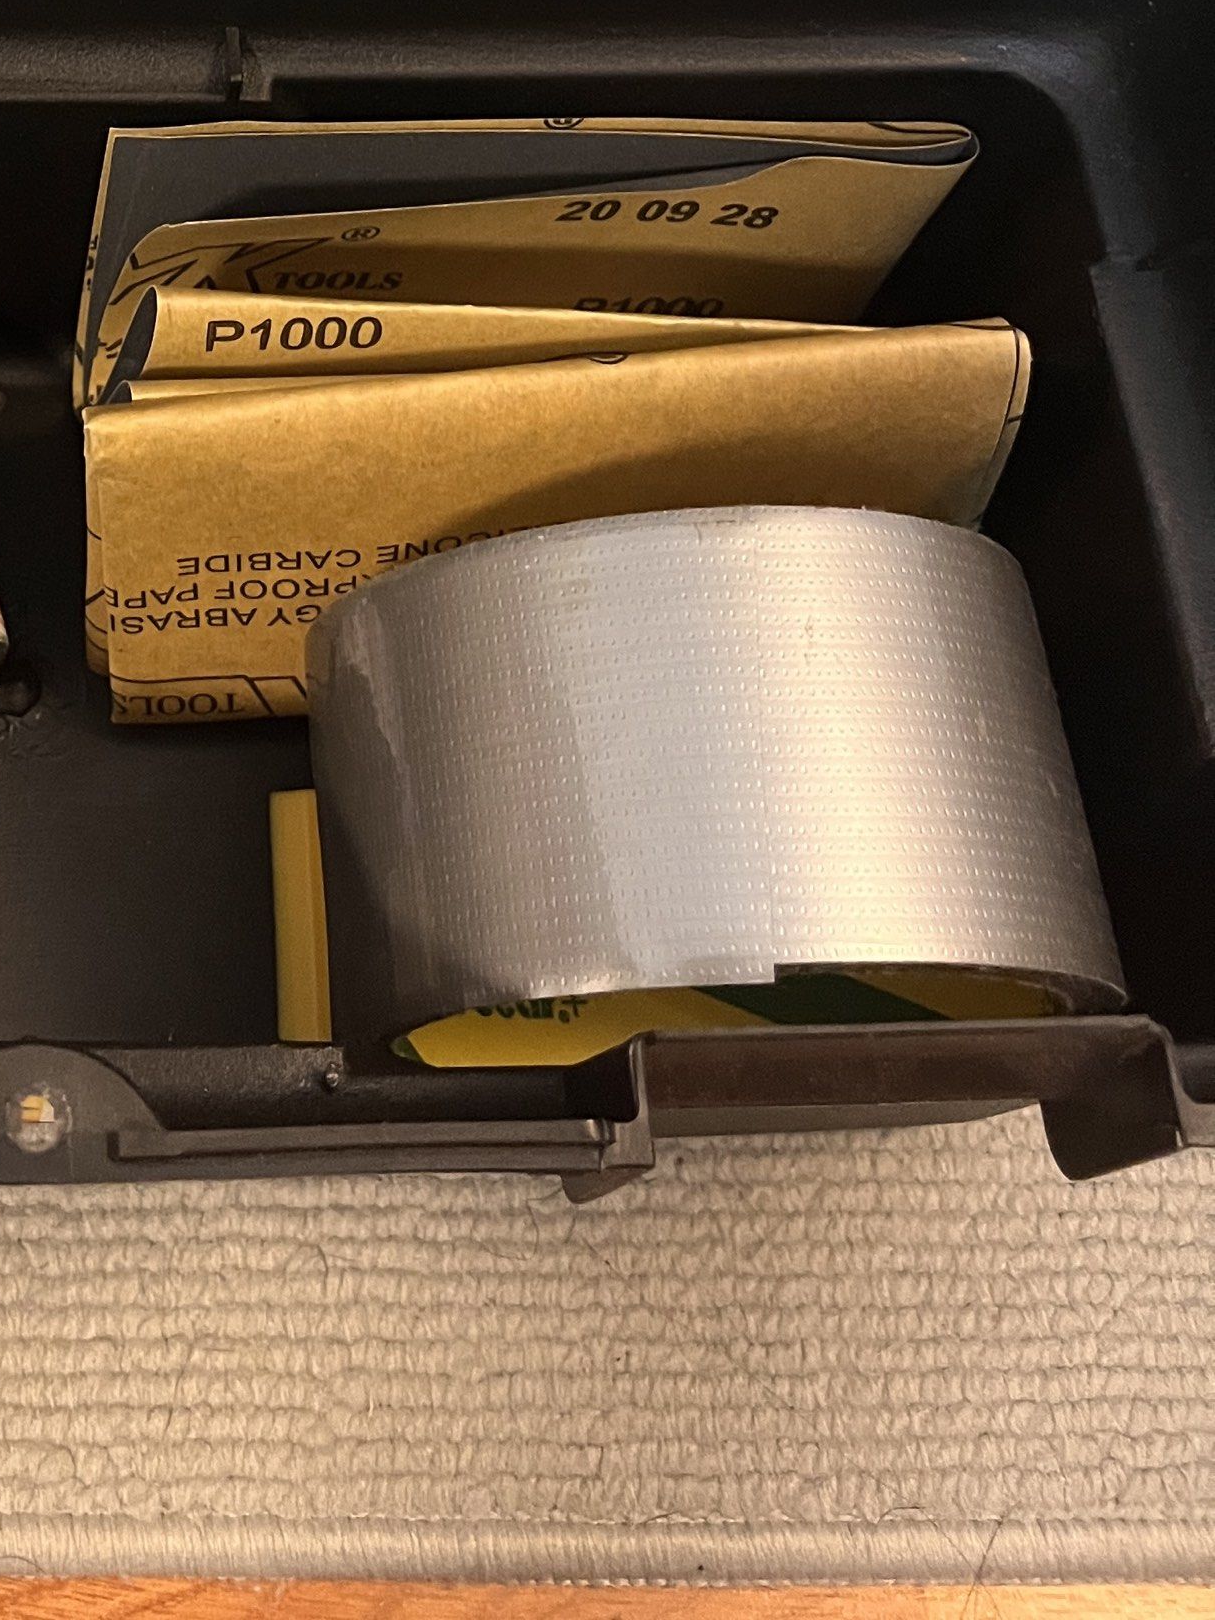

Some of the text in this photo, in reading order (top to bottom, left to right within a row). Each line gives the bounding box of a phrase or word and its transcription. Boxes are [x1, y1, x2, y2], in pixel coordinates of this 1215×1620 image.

[555, 199, 779, 229] 20 09 28
[274, 270, 403, 292] TOOLS
[205, 316, 383, 353] P1000
[176, 548, 362, 577] CARBIDE
[215, 575, 362, 600] PROOF
[267, 604, 323, 627] GY
